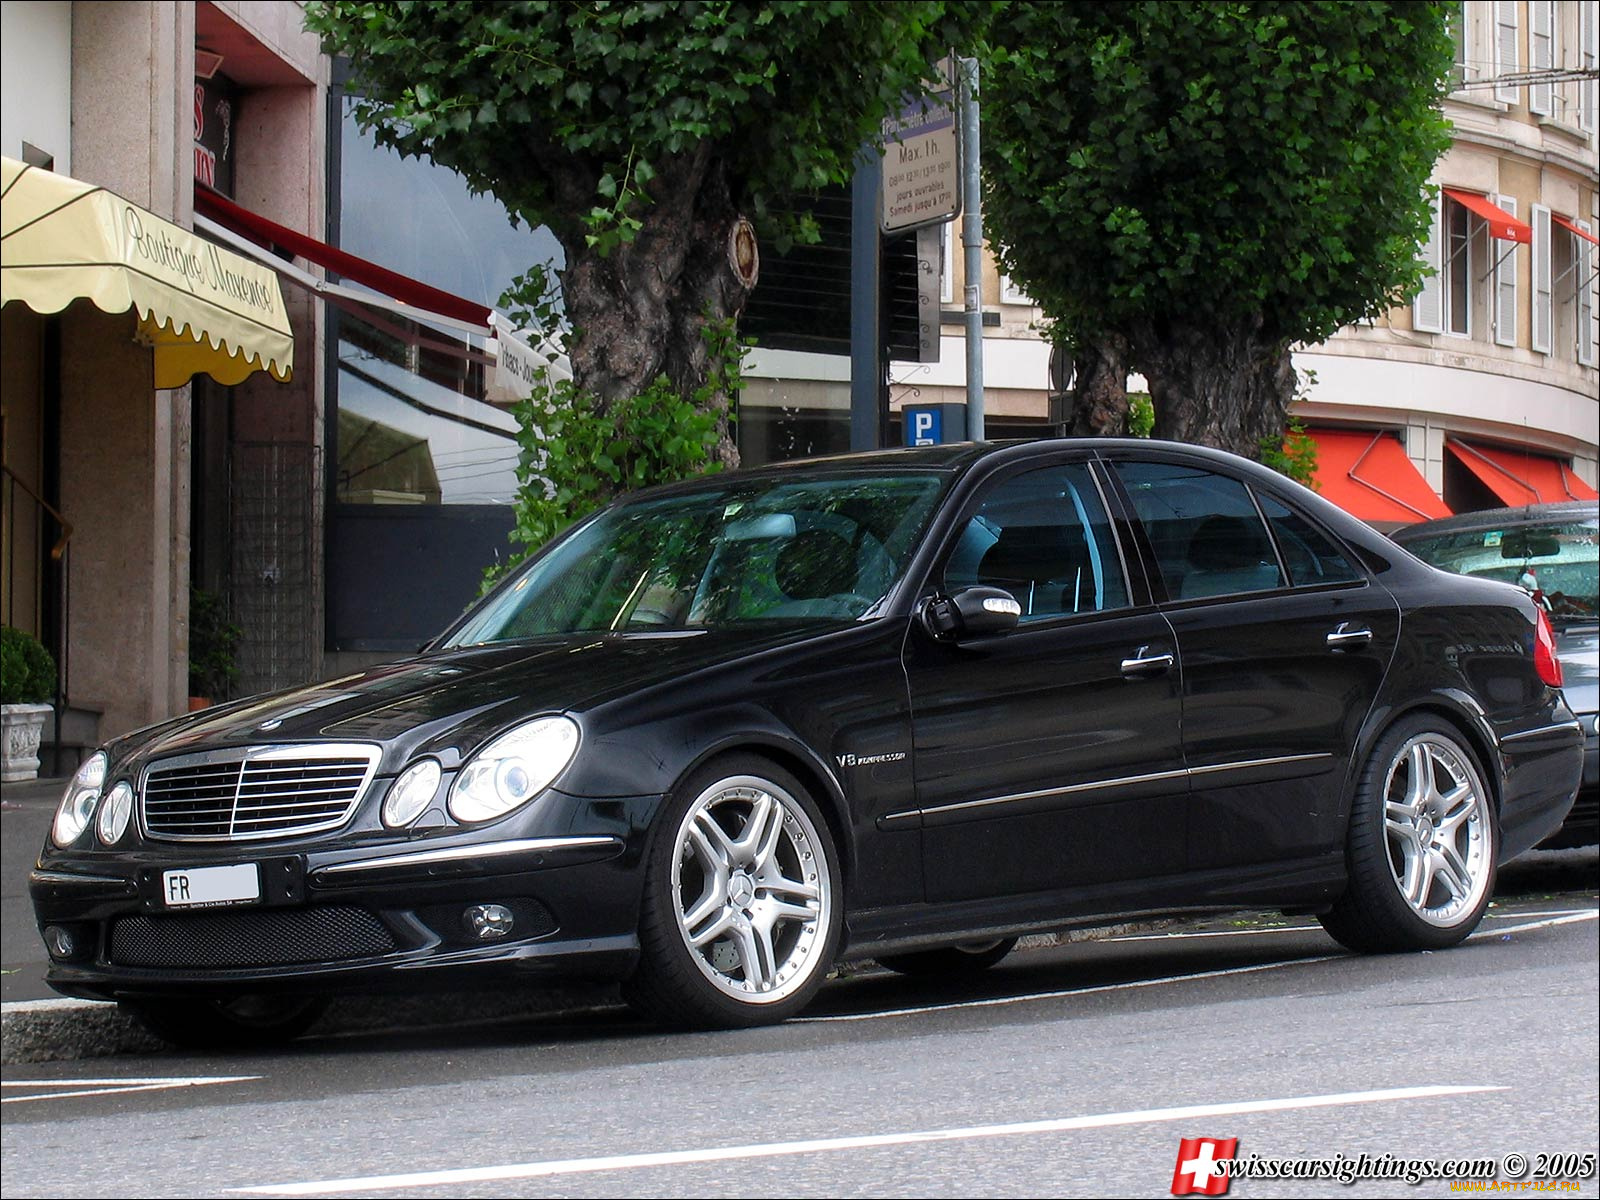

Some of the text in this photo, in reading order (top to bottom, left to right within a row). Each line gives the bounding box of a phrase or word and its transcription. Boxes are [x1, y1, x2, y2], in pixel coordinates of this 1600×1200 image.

[900, 146, 922, 164] Max.
[896, 190, 912, 204] jours
[889, 202, 913, 217] Samedi
[125, 206, 274, 314] Boutique Maxence
[915, 412, 933, 439] P
[836, 753, 856, 768] V8
[169, 875, 191, 900] FR
